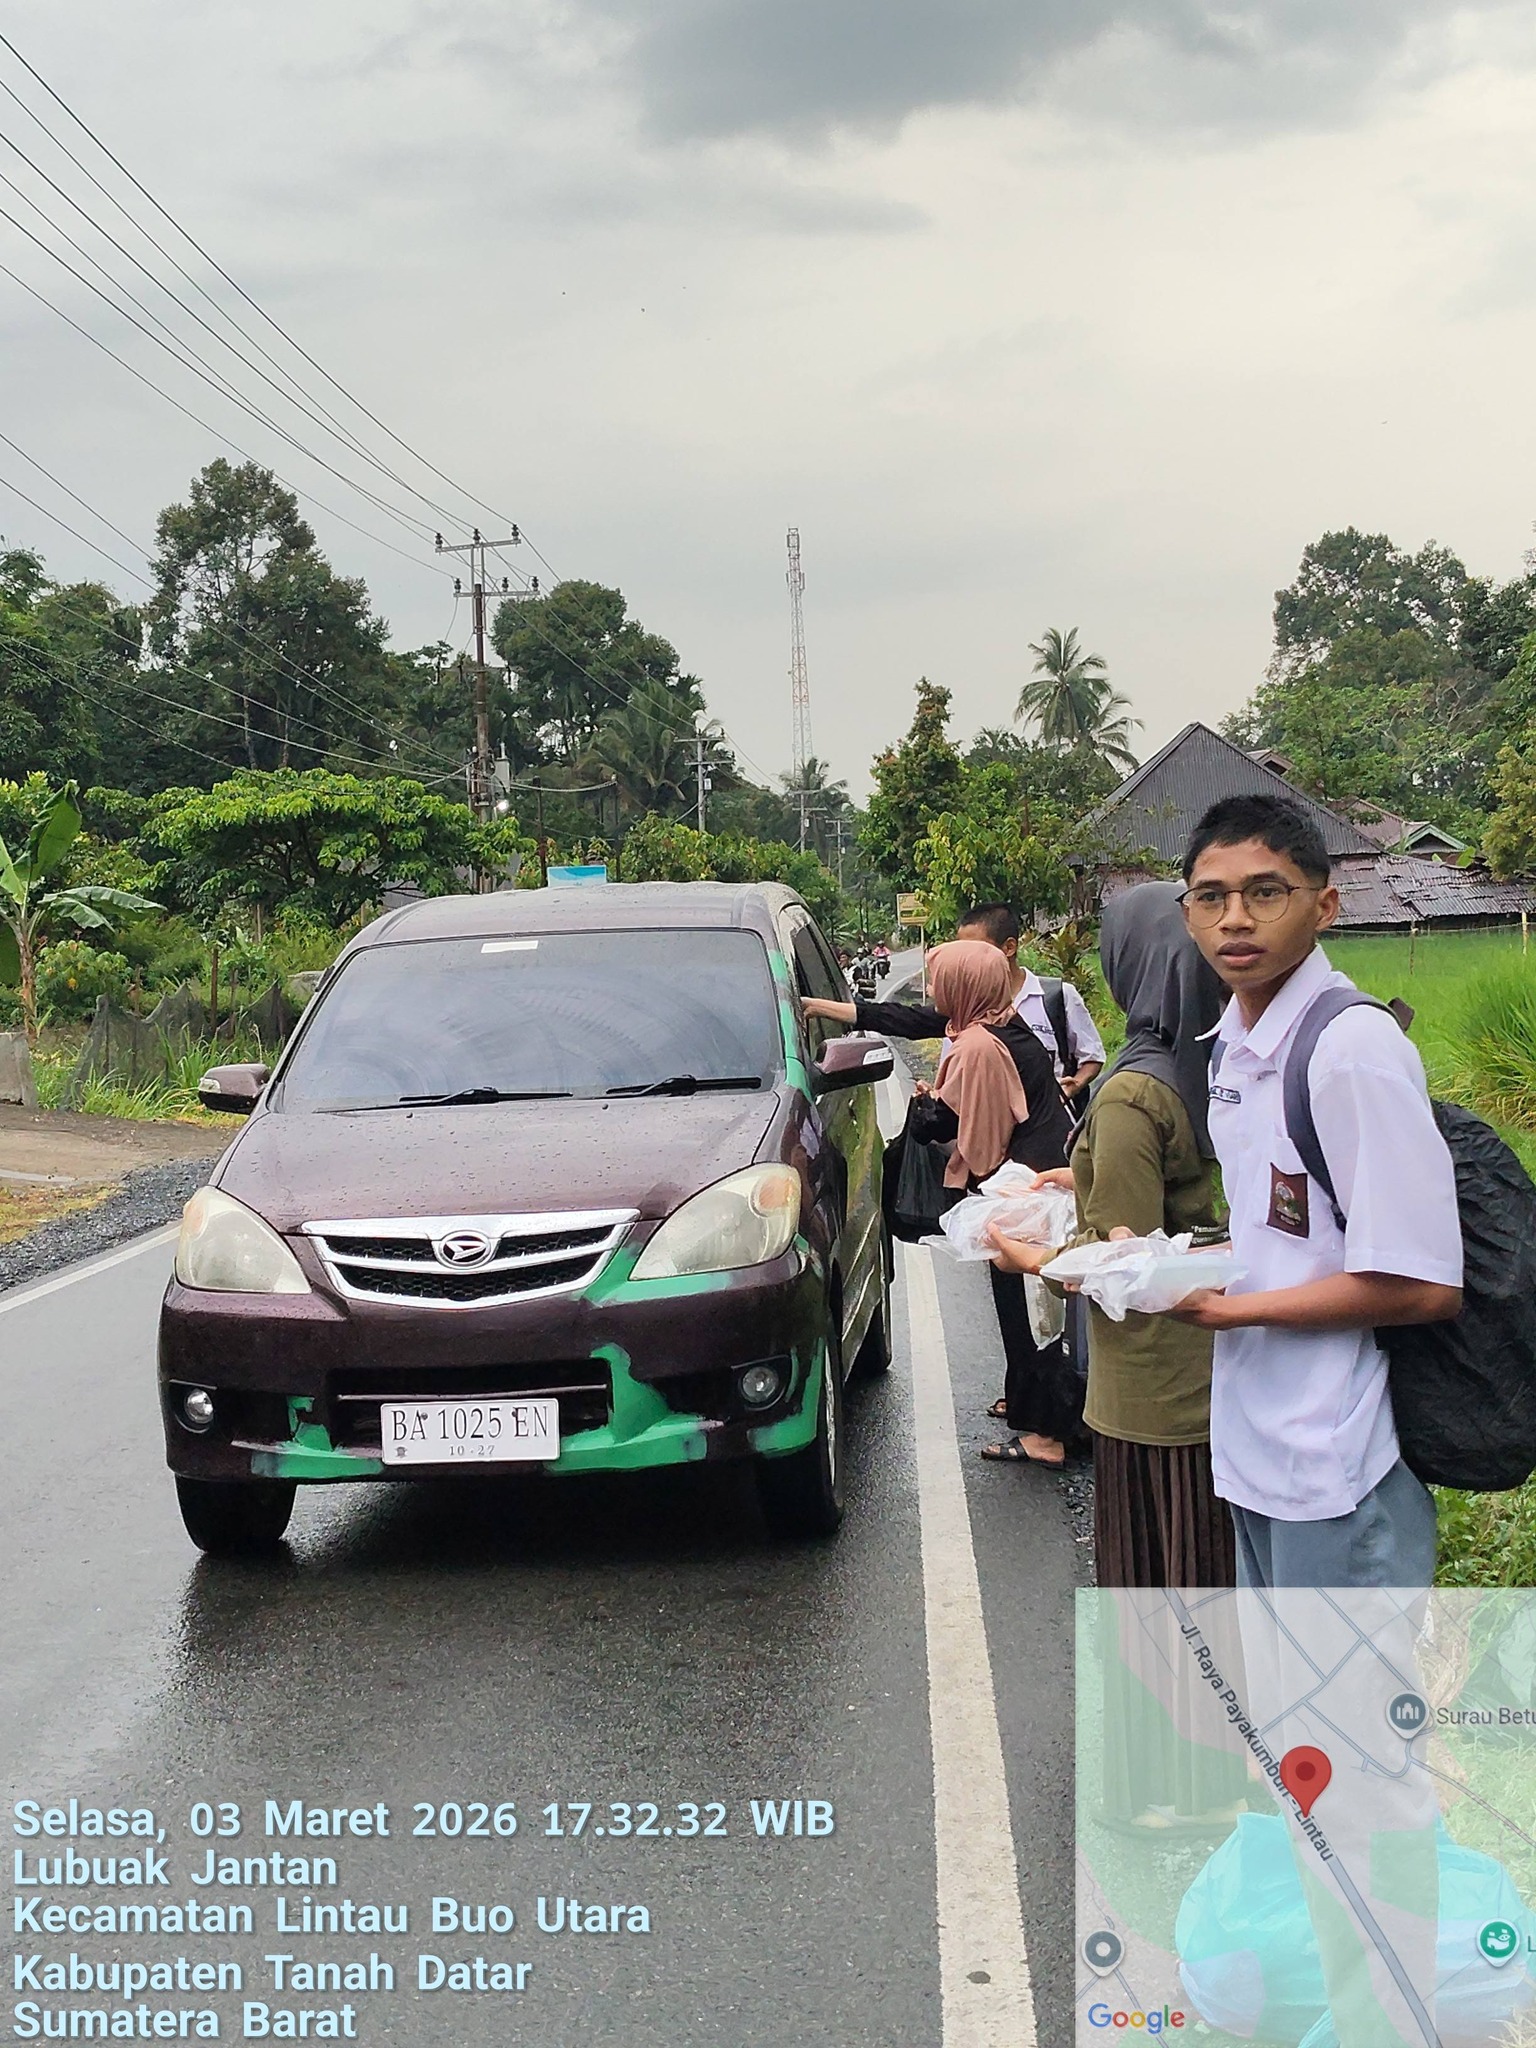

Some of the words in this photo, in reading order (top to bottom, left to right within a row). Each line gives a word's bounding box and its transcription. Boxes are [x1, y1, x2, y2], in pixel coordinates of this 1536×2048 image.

[391, 1410, 427, 1441] BA
[437, 1407, 503, 1440] 1025
[513, 1405, 549, 1438] EN
